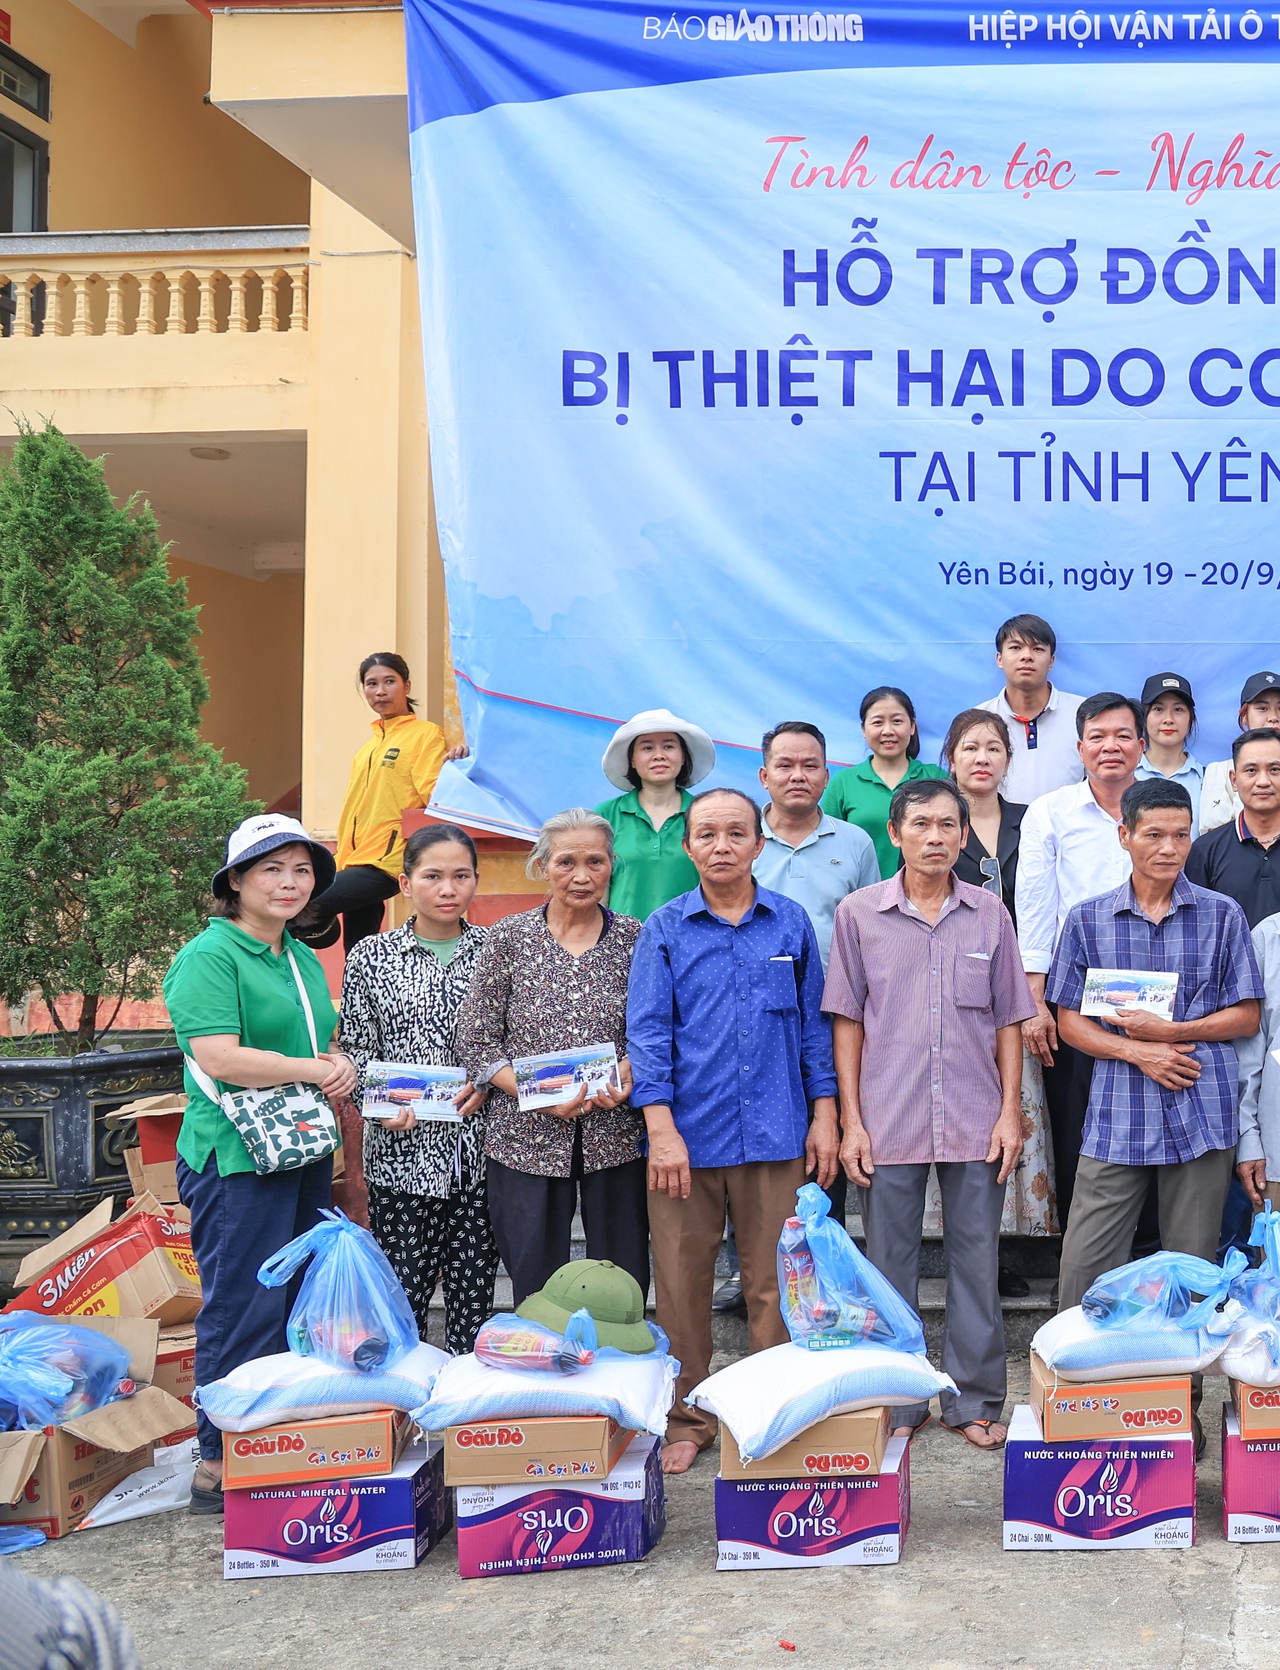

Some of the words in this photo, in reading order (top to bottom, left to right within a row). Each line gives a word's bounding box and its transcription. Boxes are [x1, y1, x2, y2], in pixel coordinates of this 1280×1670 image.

[643, 12, 706, 41] BÁO
[969, 10, 1038, 49] HIỆP
[1047, 9, 1101, 48] HỘI
[1114, 10, 1174, 48] VẬN
[1182, 8, 1231, 41] TẢI
[1239, 8, 1264, 41] Ô
[764, 134, 878, 193] Tình
[890, 133, 990, 191] dân
[1003, 141, 1076, 200] tộc
[1094, 169, 1121, 177] -
[782, 217, 893, 307] HỖ
[915, 238, 1080, 324] TRỢ
[561, 349, 631, 426] BỊ
[652, 333, 873, 426] THIỆT
[896, 348, 1026, 426] HẠI
[1051, 347, 1166, 407] DO
[878, 450, 976, 518] TẠI
[997, 430, 1150, 502] TỈNH
[938, 560, 990, 586] Yên
[999, 560, 1054, 590] Bái,
[1062, 561, 1134, 591] ngày
[1142, 561, 1174, 586] 19
[1024, 1450, 1055, 1460] NƯỚC
[1057, 1449, 1103, 1460] KHOÁNG
[1105, 1450, 1138, 1460] THIÊN
[1141, 1450, 1175, 1460] NHIÊN
[736, 1482, 766, 1492] NƯỚC
[768, 1481, 811, 1491] KHOÁNG
[813, 1480, 845, 1490] THIÊN
[847, 1479, 879, 1490] NHIÊN
[250, 1489, 298, 1500] NATURAL
[300, 1487, 348, 1498] MINERAL
[349, 1485, 386, 1496] WATER
[1154, 1530, 1189, 1540] KHOÁNG
[1233, 1526, 1241, 1535] 24
[1241, 1525, 1260, 1535] Bottles
[1263, 1524, 1275, 1534] 500
[1009, 1533, 1017, 1543] 24
[1017, 1533, 1030, 1543] Chai
[1033, 1533, 1044, 1543] 500
[1044, 1533, 1053, 1542] ML
[375, 1549, 408, 1559] KHOÁNG
[597, 1547, 626, 1559] NƯỚC
[862, 1544, 894, 1554] KHOÁNG
[516, 1555, 548, 1567] THIÊN
[551, 1551, 595, 1564] KHOÁNG
[479, 1558, 514, 1571] NHIÊN
